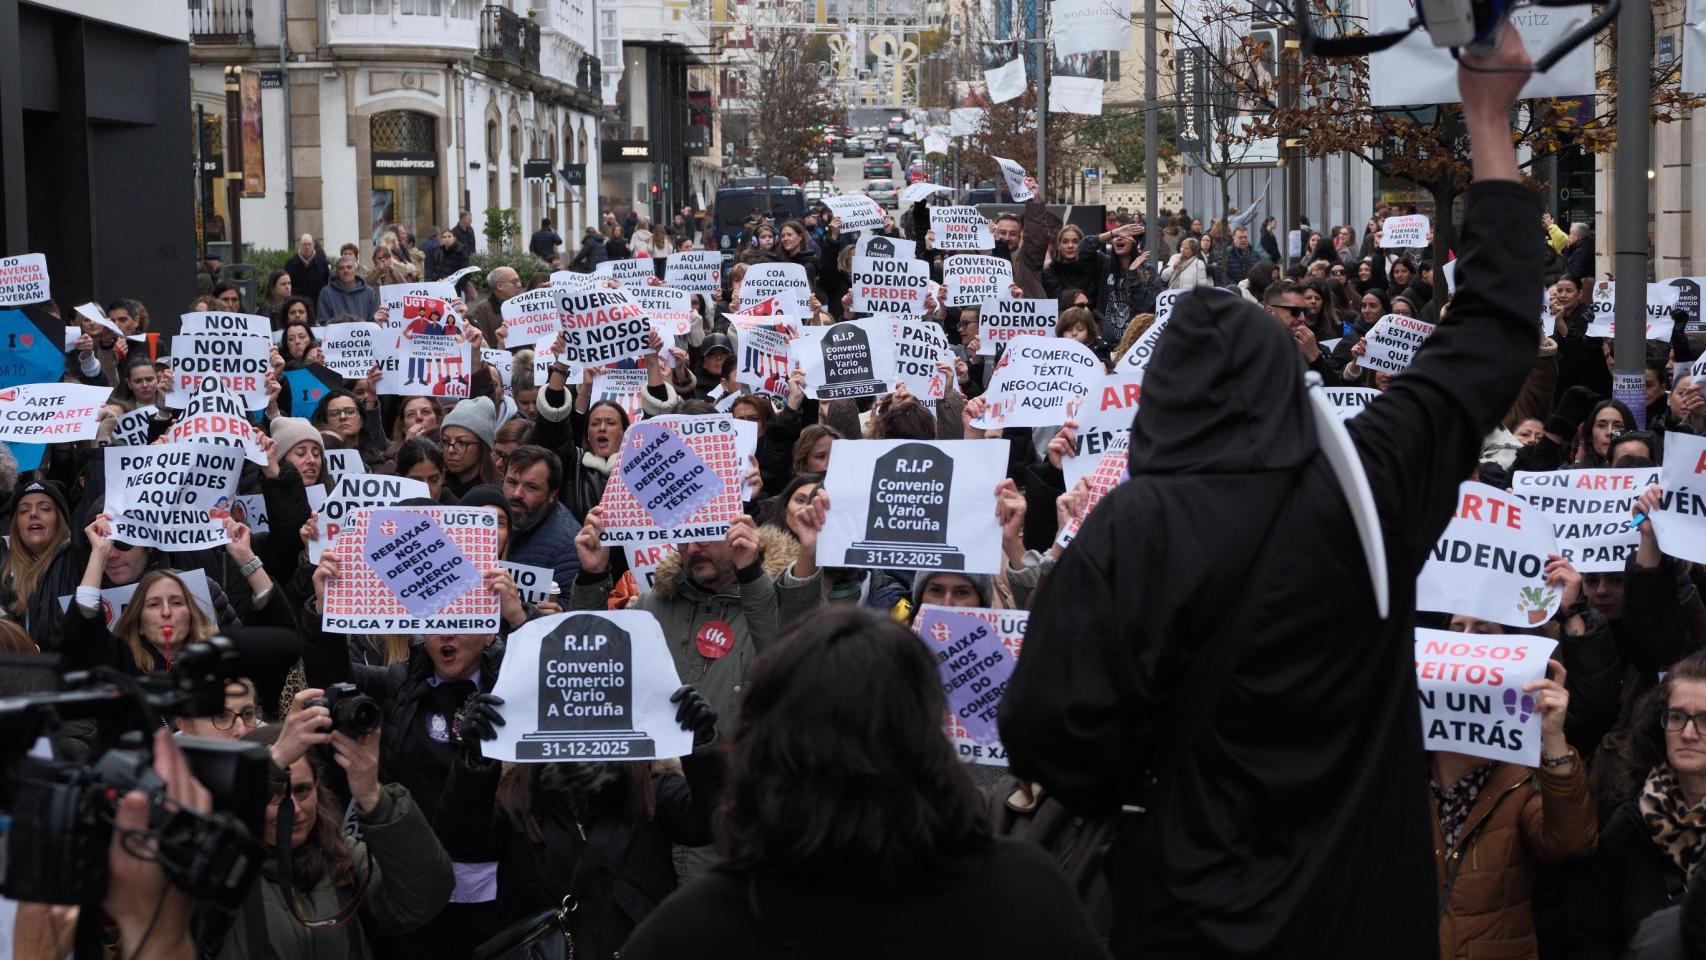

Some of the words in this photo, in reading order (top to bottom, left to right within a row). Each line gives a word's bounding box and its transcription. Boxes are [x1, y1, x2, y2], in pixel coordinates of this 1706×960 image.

[946, 224, 968, 232] NON
[946, 232, 978, 240] PARIPÉ
[681, 253, 704, 262] AQUÍ
[949, 258, 1005, 268] CONVENIO
[613, 260, 637, 270] AQUÍ
[872, 260, 908, 272] NON
[18, 282, 39, 292] NOS
[745, 279, 806, 288] NEGOCIACIÓN
[853, 273, 928, 288] PODEMOS
[861, 287, 917, 300] PERDER
[960, 284, 998, 294] PARIPÉ
[404, 296, 426, 307] UGT
[562, 292, 628, 315] QUEREN
[868, 300, 911, 314] NADA
[1000, 302, 1036, 313] NON
[206, 316, 248, 330] NON
[560, 303, 644, 330] ESMAGAR
[981, 315, 1056, 327] PODEMOS
[350, 330, 370, 338] COA
[527, 324, 554, 334] AQUI!
[563, 330, 581, 346] OS
[587, 316, 650, 345] NOSOS
[832, 332, 855, 342] R.I.P
[1376, 335, 1409, 350] MOITO
[194, 340, 242, 355] NON
[567, 334, 650, 362] DEREITOS
[826, 344, 866, 354] Convenio
[827, 352, 867, 360] Comercio
[1022, 348, 1094, 368] COMERCIO
[1388, 350, 1409, 363] QUE
[172, 358, 268, 373] PODEMOS
[838, 366, 869, 376] Coruña
[1032, 363, 1074, 378] TÉXTIL
[829, 386, 874, 397] 31-12-2025
[25, 396, 66, 406] ARTE
[1022, 396, 1063, 409] AQUI!!
[6, 408, 94, 421] COMPARTE
[13, 422, 82, 434] REPARTE
[174, 416, 250, 442] PERDER
[682, 422, 715, 435] UGT
[623, 431, 670, 474] REBAIXAS
[120, 455, 152, 470] POR
[156, 452, 190, 468] QUE
[196, 454, 236, 471] NON
[640, 452, 663, 472] NOS
[896, 459, 933, 473] R.I.P
[635, 449, 685, 492] DEREITOS
[126, 471, 226, 490] NEGOCIADES
[657, 472, 675, 488] DO
[878, 478, 944, 492] Convenio
[1520, 475, 1570, 488] CON
[1576, 474, 1638, 490] ARTE,
[342, 479, 401, 498] NON
[647, 465, 704, 510] COMERCIO
[663, 481, 704, 510] TÉXTIL
[876, 491, 944, 505] Comercio
[122, 508, 210, 525] CONVENIO
[887, 505, 925, 517] Vario
[444, 513, 479, 526] UGT
[874, 517, 884, 528] A
[888, 516, 940, 531] Coruña
[116, 522, 224, 544] PROVINCIAL?
[636, 531, 644, 540] 7
[649, 529, 668, 540] DE
[371, 520, 430, 562] REBAIXAS
[395, 541, 422, 560] NOS
[387, 539, 445, 580] DEREITOS
[866, 551, 942, 566] 31-12-2025
[413, 561, 433, 577] DO
[400, 556, 462, 599] COMERCIO
[418, 573, 460, 601] TÉXTIL
[326, 618, 380, 629] FOLGA
[385, 619, 394, 629] 7
[400, 619, 420, 629] DE
[425, 618, 496, 629] XANEIRO
[565, 635, 607, 651] R.I.P
[1424, 640, 1528, 662] NOSOS
[547, 660, 624, 673] Convenio
[949, 650, 977, 672] NOS
[943, 651, 1003, 694] DEREITOS
[546, 674, 624, 688] Comercio
[970, 676, 991, 694] DO
[562, 689, 605, 702] Vario
[547, 705, 558, 717] A
[564, 703, 624, 717] Coruña
[1446, 692, 1491, 714] UN
[1428, 720, 1523, 752] ATRÁS
[542, 742, 629, 756] 31-12-2025
[960, 744, 982, 758] DE
